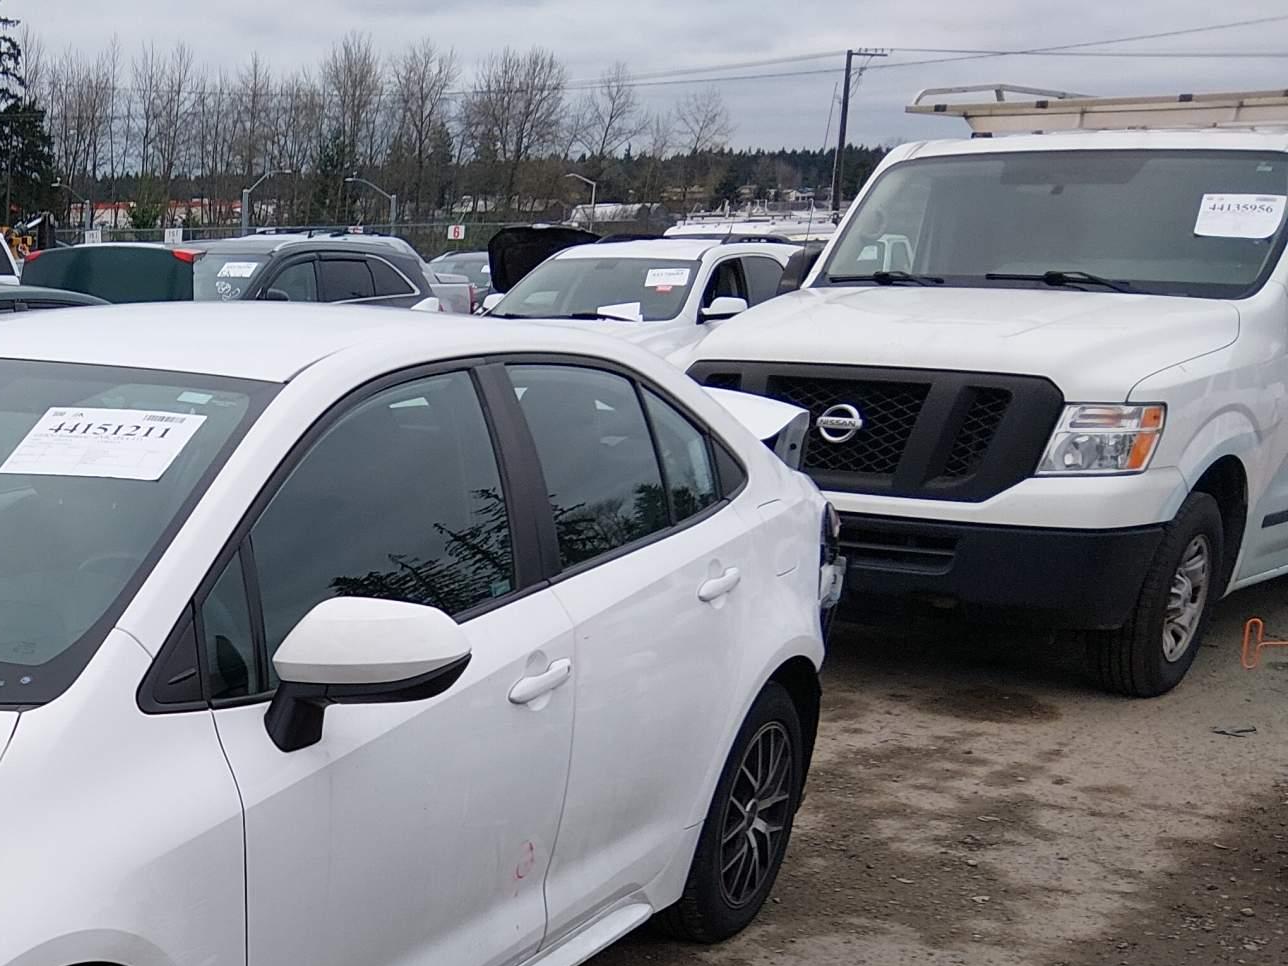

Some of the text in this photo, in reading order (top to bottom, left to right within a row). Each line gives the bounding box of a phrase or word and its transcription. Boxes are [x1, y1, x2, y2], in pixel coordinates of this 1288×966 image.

[1208, 203, 1274, 213] 44135956
[452, 226, 460, 239] 6
[819, 418, 857, 427] NISSAN
[48, 421, 171, 439] 44151211
